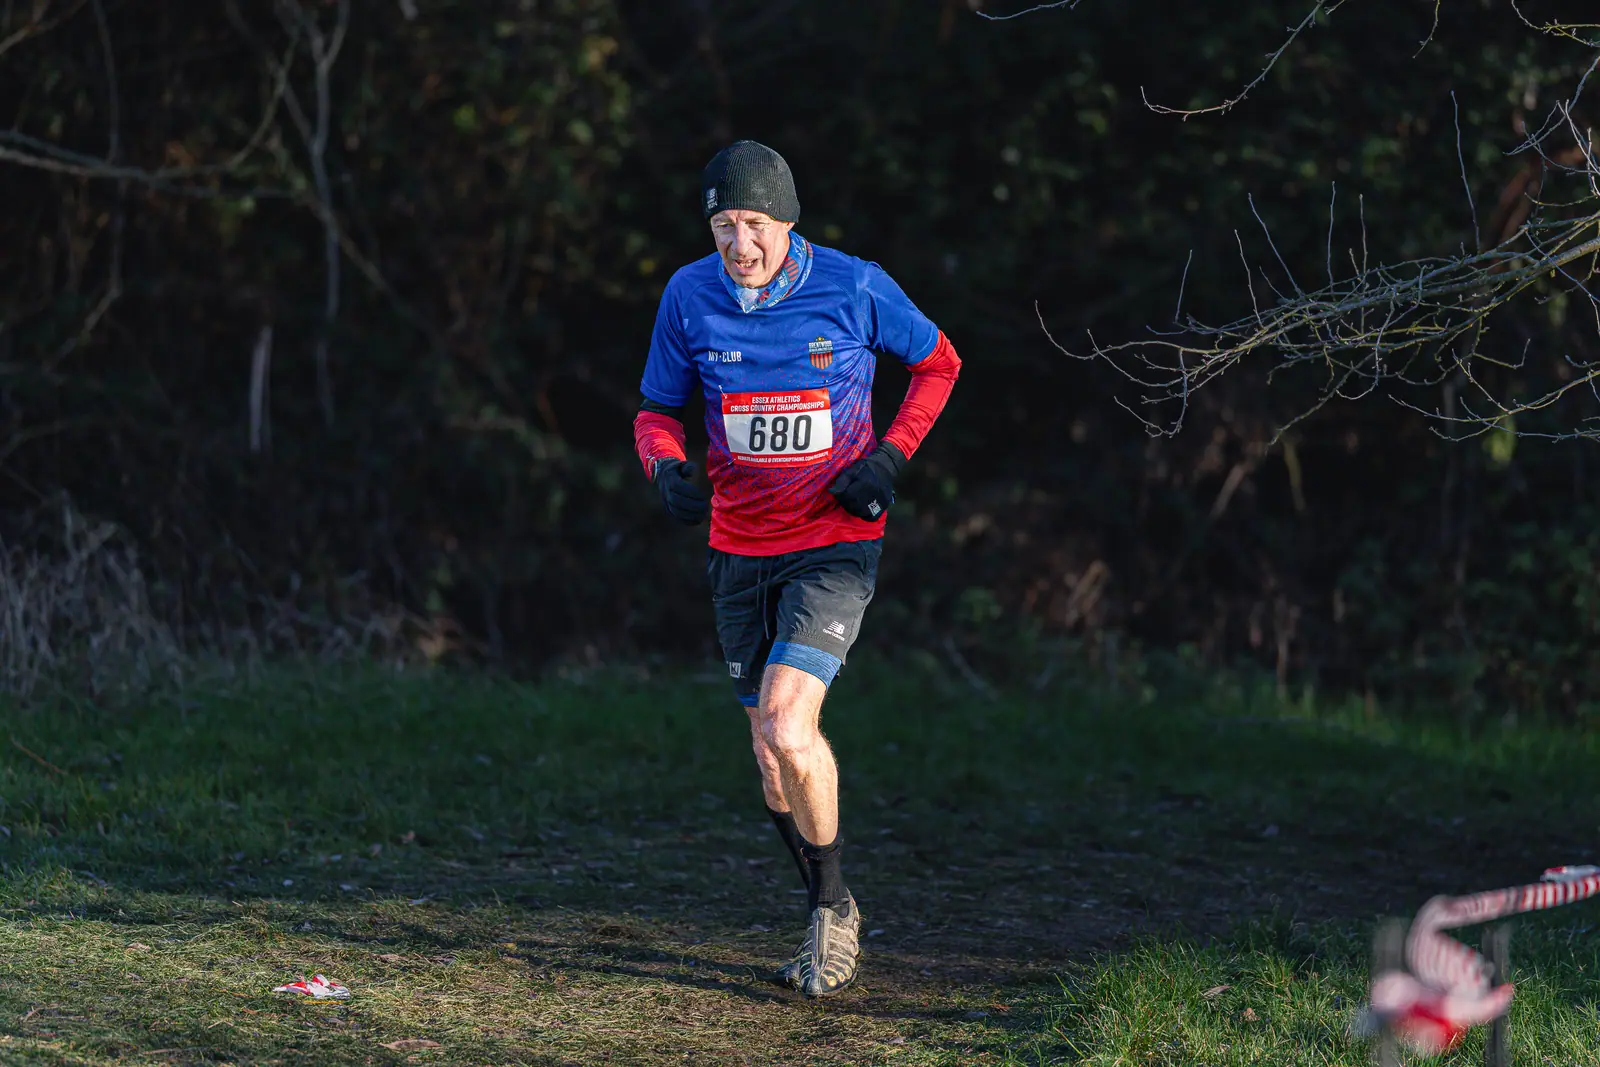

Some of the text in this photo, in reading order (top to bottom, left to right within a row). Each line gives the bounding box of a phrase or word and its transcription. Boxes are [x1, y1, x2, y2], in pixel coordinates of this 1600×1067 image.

[752, 395, 800, 404] ESSEX ATHLETICS
[750, 404, 775, 412] COUNTRY
[776, 401, 824, 411] CHAMPIONSHIPS
[749, 414, 812, 452] 680
